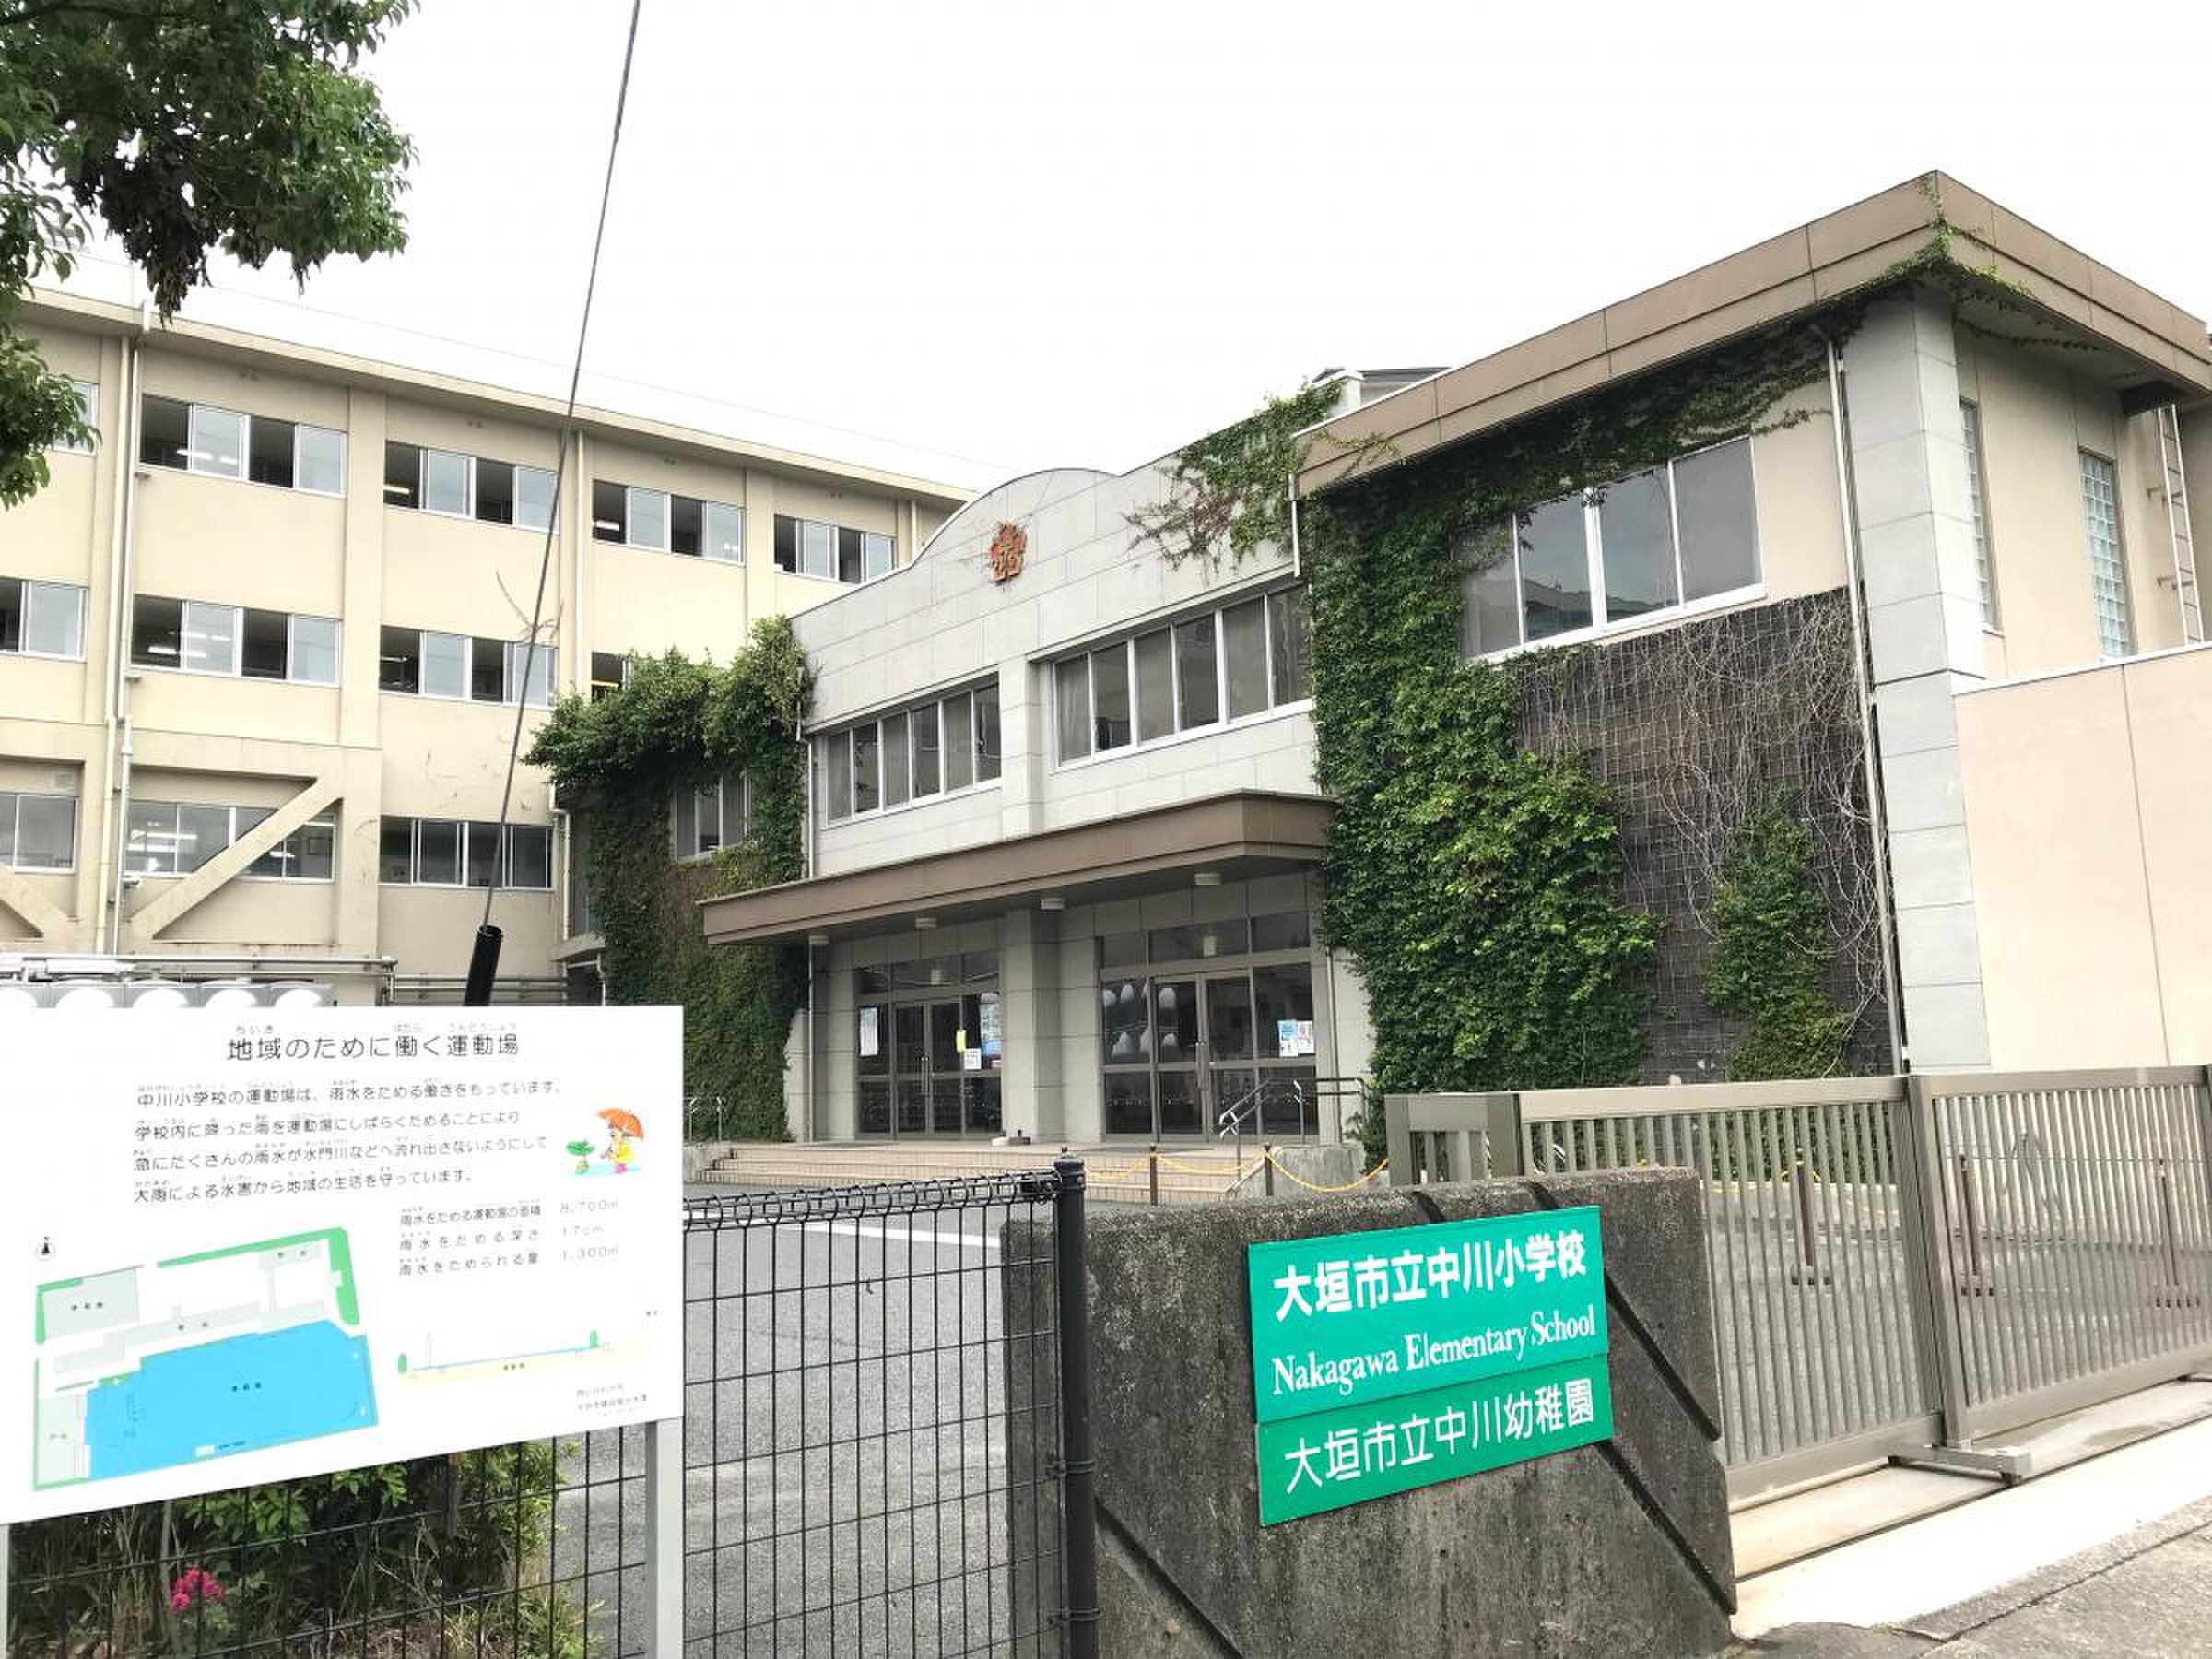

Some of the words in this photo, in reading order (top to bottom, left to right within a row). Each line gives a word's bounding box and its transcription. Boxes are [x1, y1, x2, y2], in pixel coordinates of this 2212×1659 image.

[226, 1033, 519, 1061] 地域のために働く運動場
[1273, 1229, 1587, 1322] 大垣市立中川小学校
[1272, 1351, 1399, 1396] Nakagawa
[1404, 1330, 1528, 1371] Elementary
[1530, 1304, 1596, 1347] School
[1283, 1377, 1595, 1494] 大垣市立中川幼稚園
